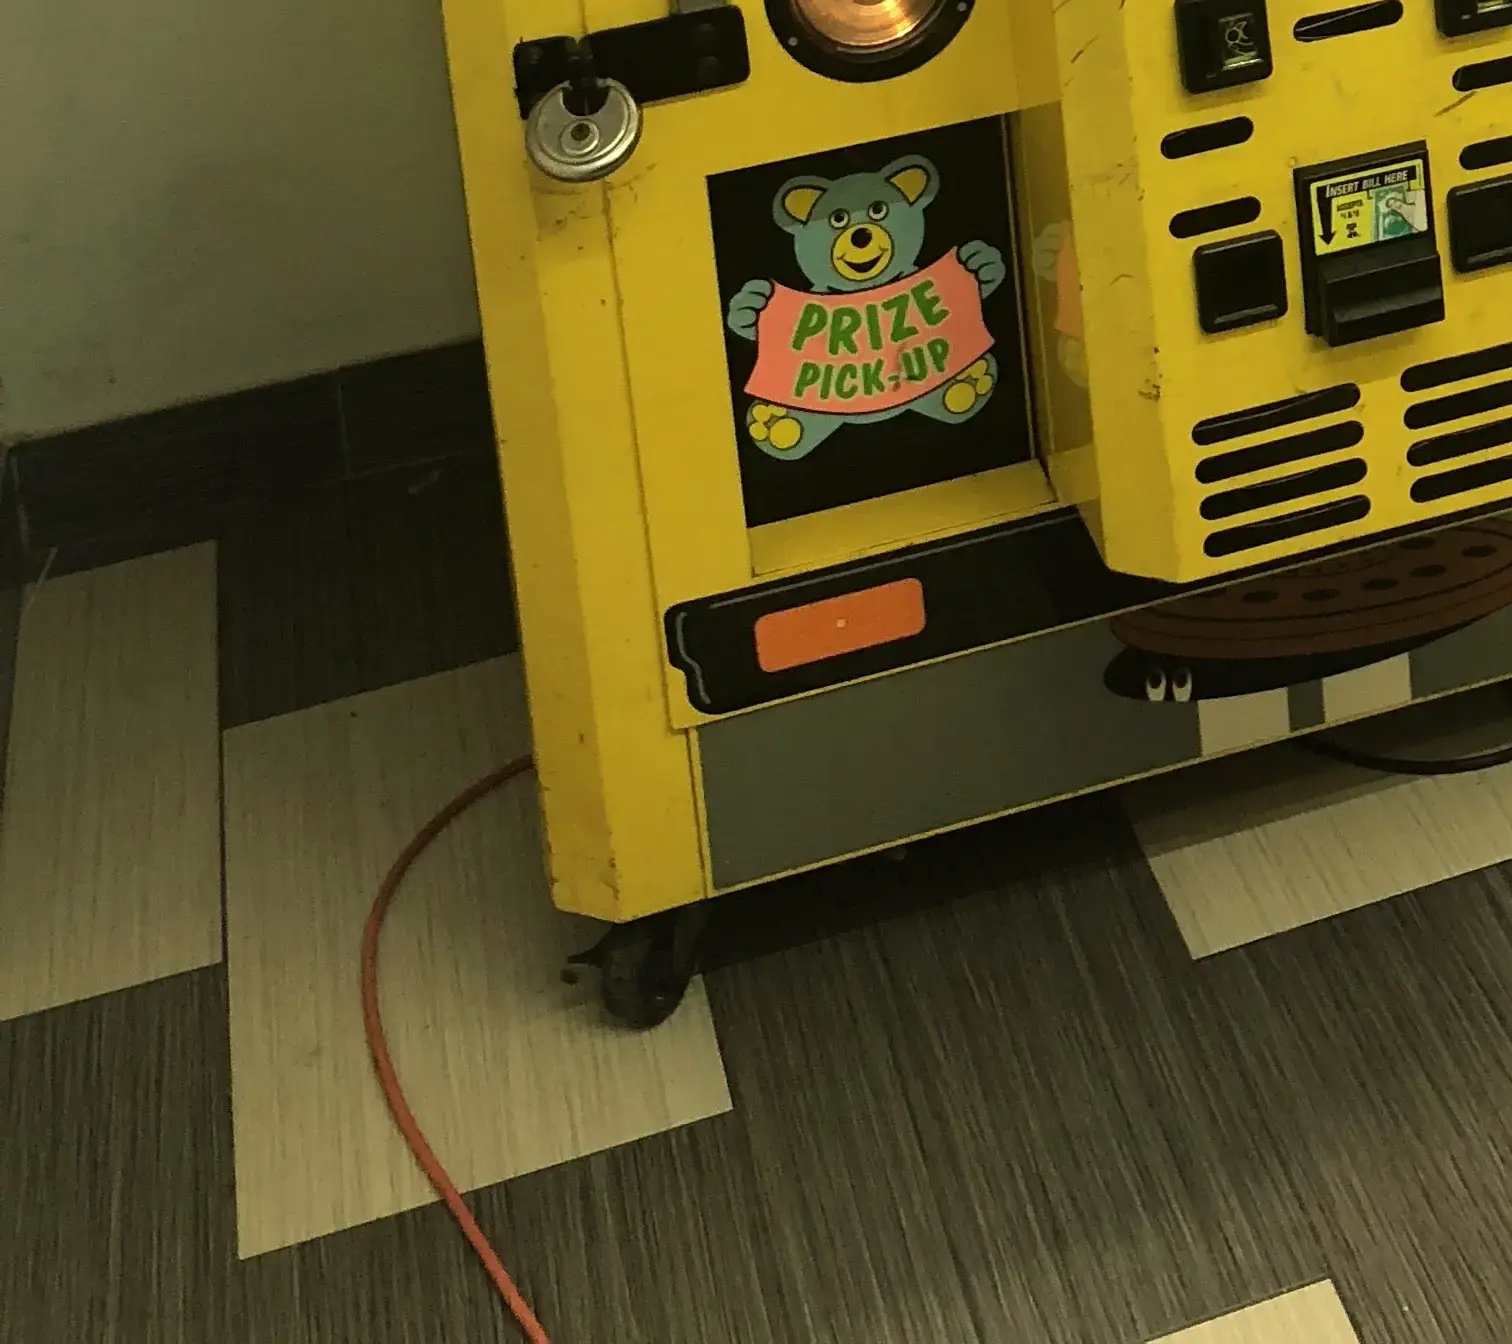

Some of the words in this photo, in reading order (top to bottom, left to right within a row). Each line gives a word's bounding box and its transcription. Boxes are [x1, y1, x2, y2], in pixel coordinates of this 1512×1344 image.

[1325, 181, 1360, 198] INSERT
[1362, 176, 1381, 190] BILL
[1384, 169, 1408, 184] HERE
[791, 279, 951, 355] PRIZE
[793, 338, 950, 400] PICK-UP
